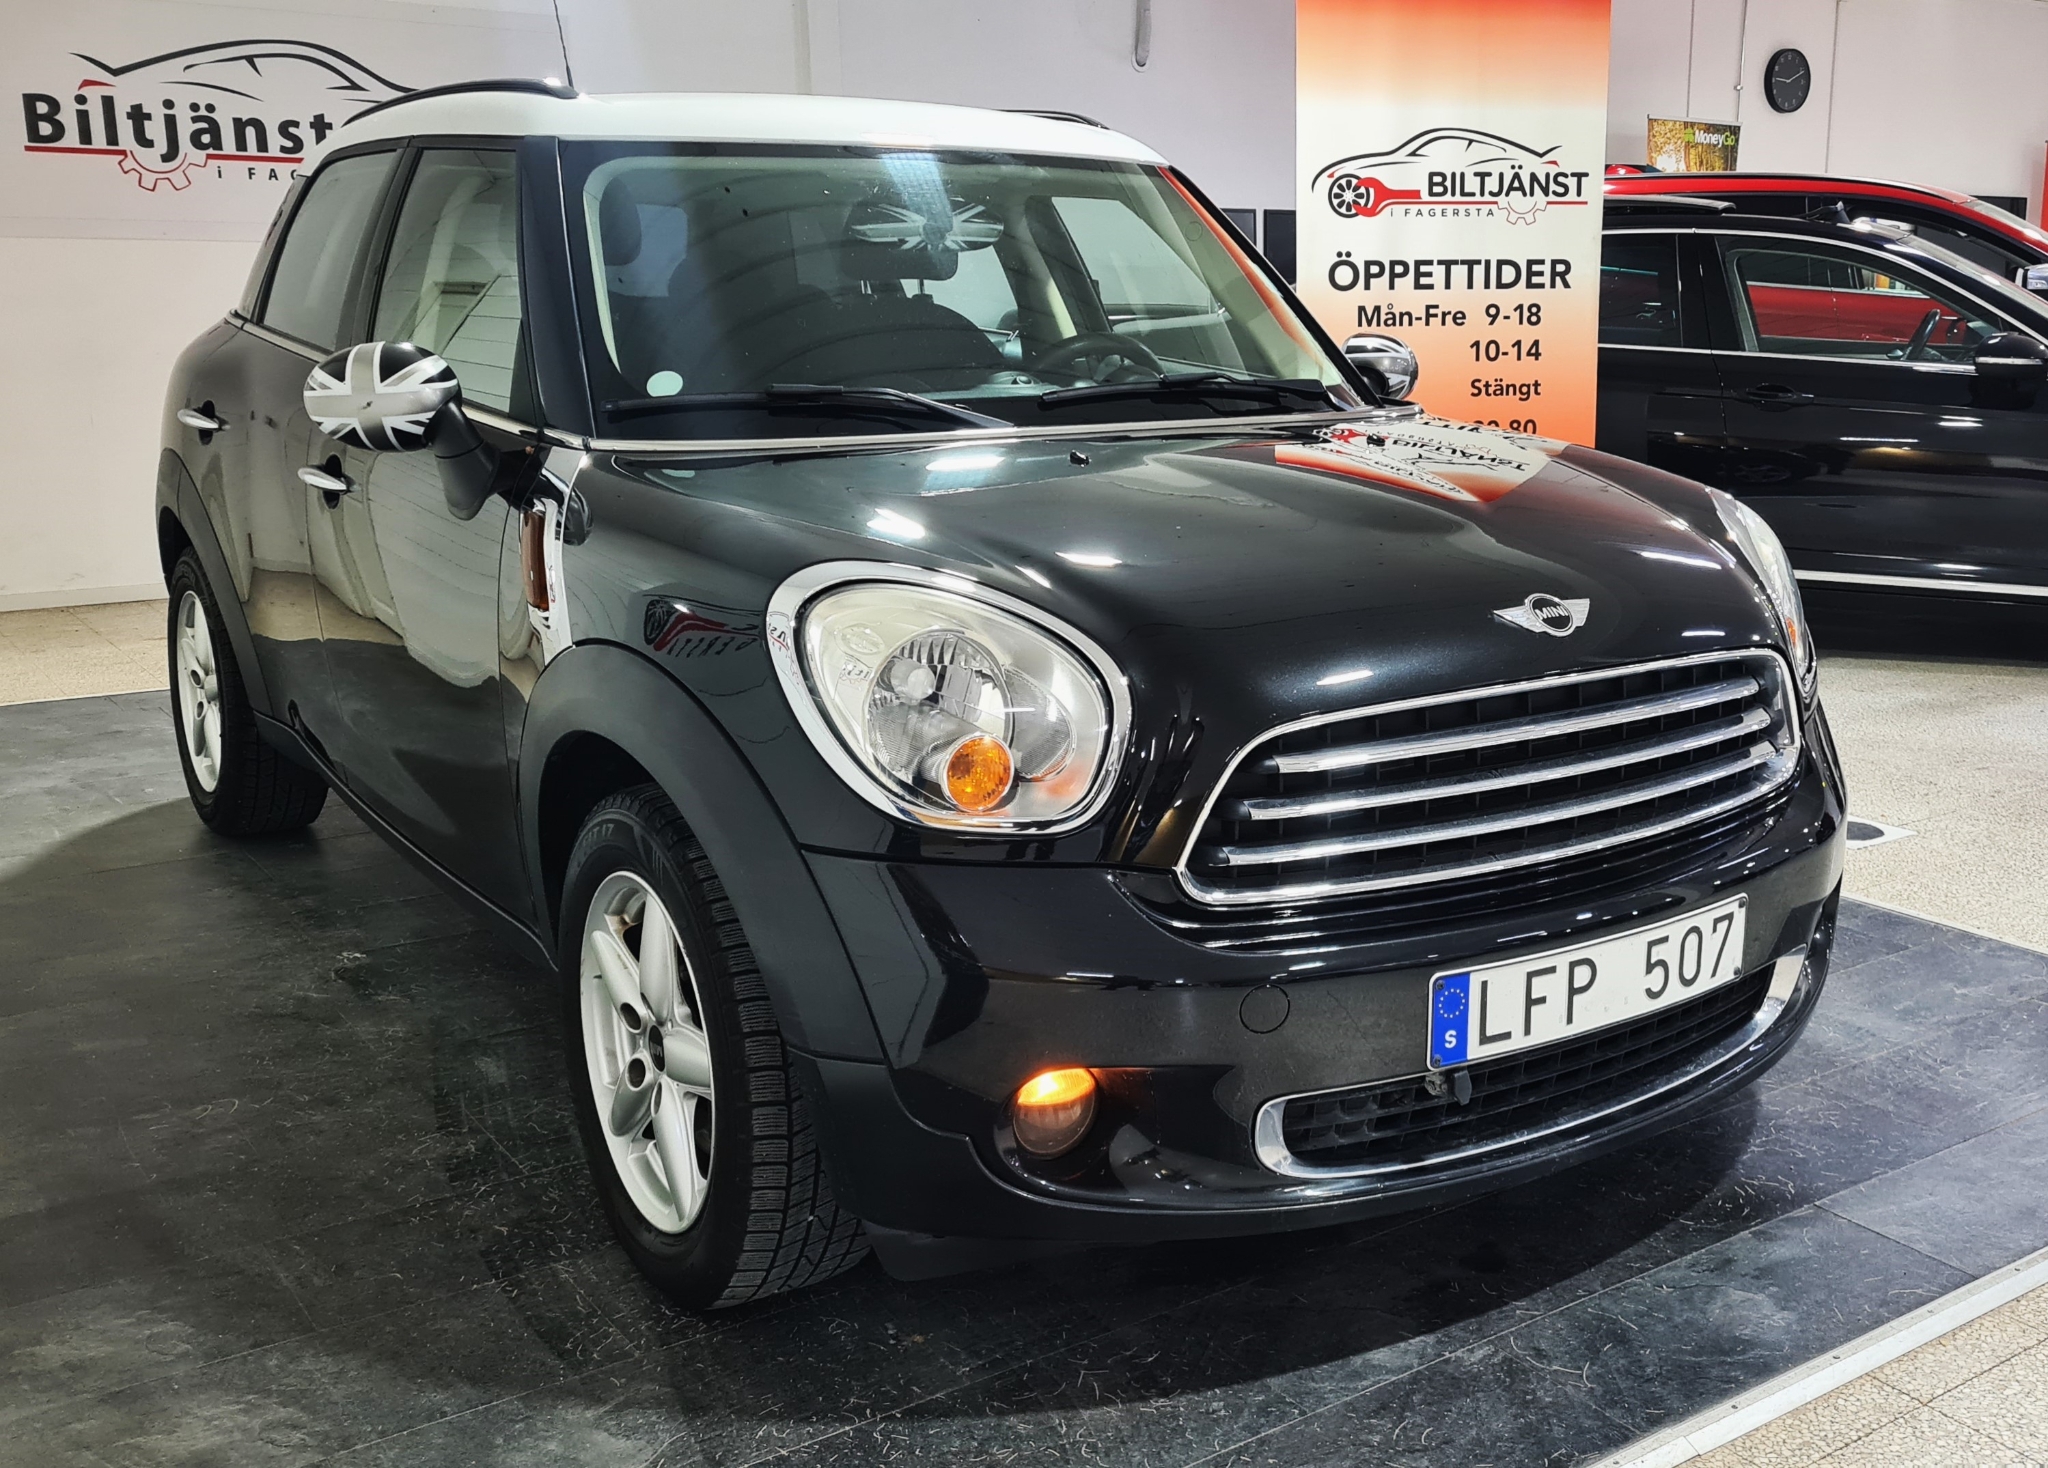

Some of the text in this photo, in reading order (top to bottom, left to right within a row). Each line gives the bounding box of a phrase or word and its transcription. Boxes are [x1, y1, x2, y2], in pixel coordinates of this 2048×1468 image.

[23, 92, 333, 163] Biltjänst
[1694, 130, 1736, 147] MoneyGo
[217, 166, 222, 179] i
[1427, 164, 1590, 198] BILTJÄNST
[1404, 207, 1495, 218] FAGERSTA
[1328, 250, 1572, 292] ÖPPETTIDER
[1357, 303, 1542, 328] Mån-Fre 9-18
[1469, 339, 1542, 362] 10-14
[1470, 378, 1541, 401] Stängt
[1534, 605, 1569, 620] MINI
[1478, 911, 1735, 1047] LFP 507
[1444, 1030, 1457, 1048] S
